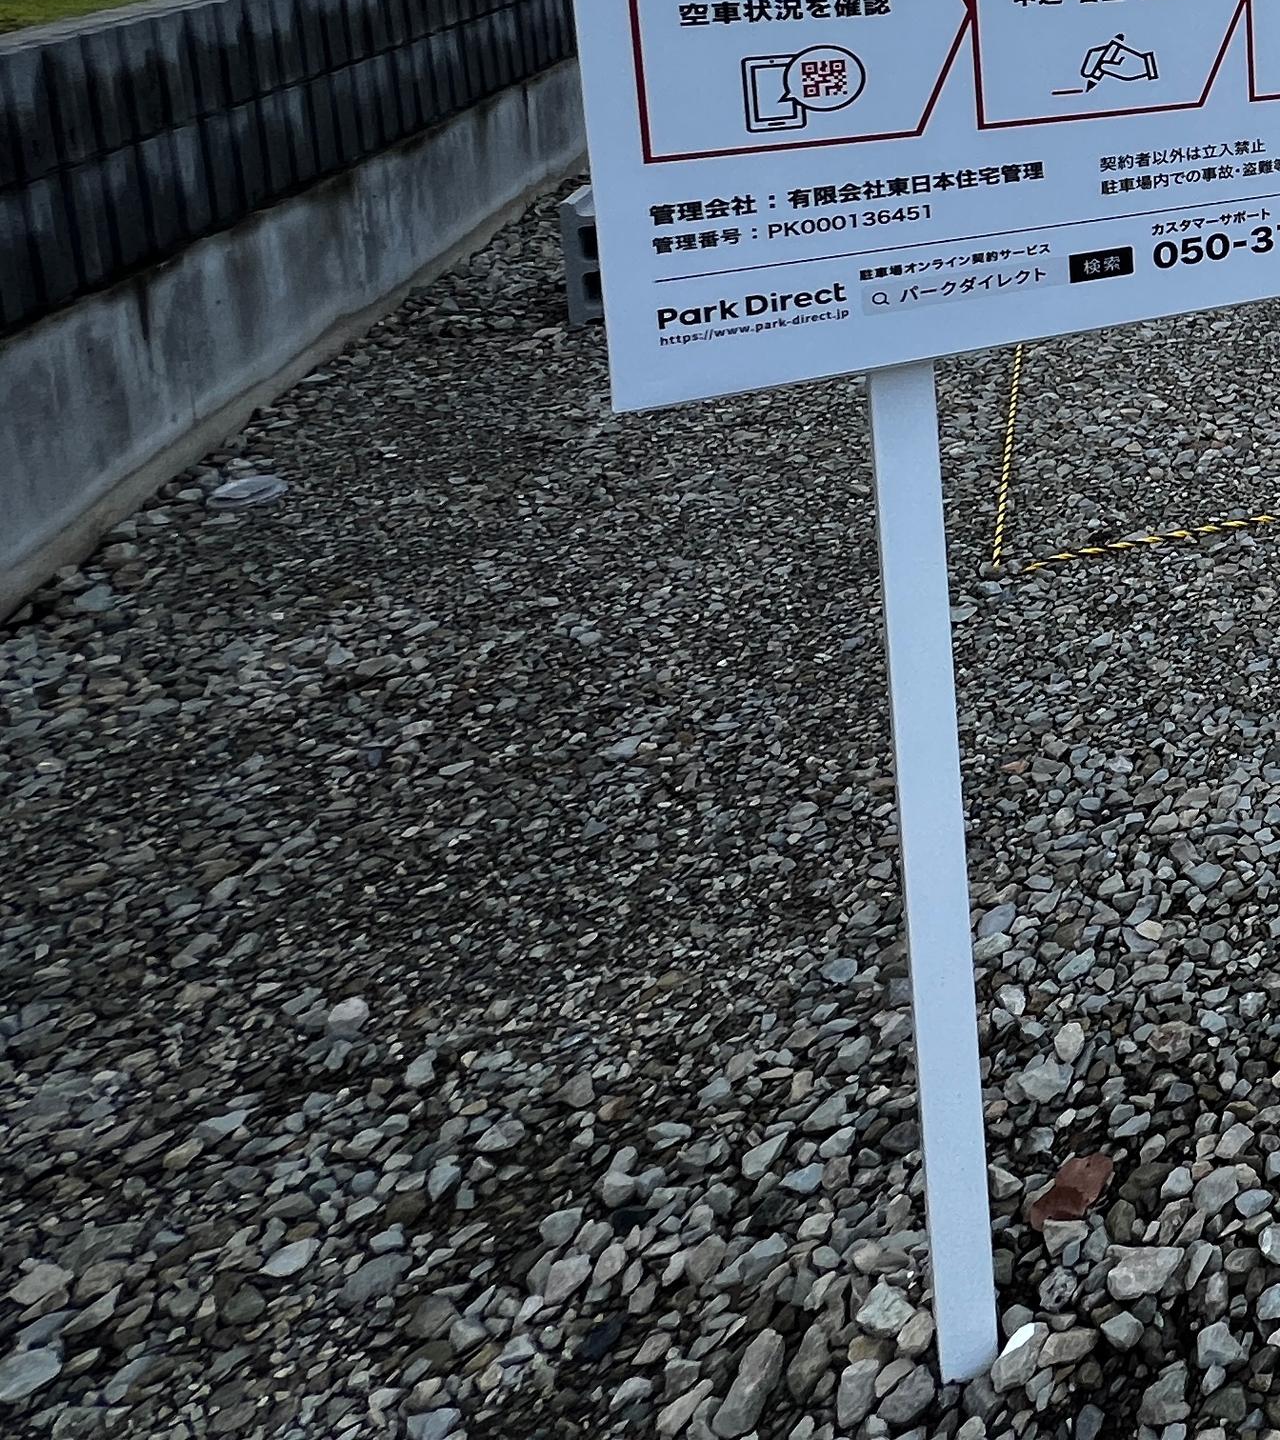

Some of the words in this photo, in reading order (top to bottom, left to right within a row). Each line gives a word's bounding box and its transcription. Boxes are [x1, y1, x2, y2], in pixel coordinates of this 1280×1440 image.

[1100, 138, 1266, 173] 契約者以外は立入禁止
[1152, 208, 1271, 236] カスタマーサポート
[859, 243, 1051, 282] 駐車場オンライン契約サービス
[899, 267, 1048, 304] パークダイレクト
[1083, 256, 1122, 276] 検索
[656, 299, 739, 331] Park
[745, 282, 848, 318] Direct
[660, 308, 850, 347] https://www.park-direct.jp
